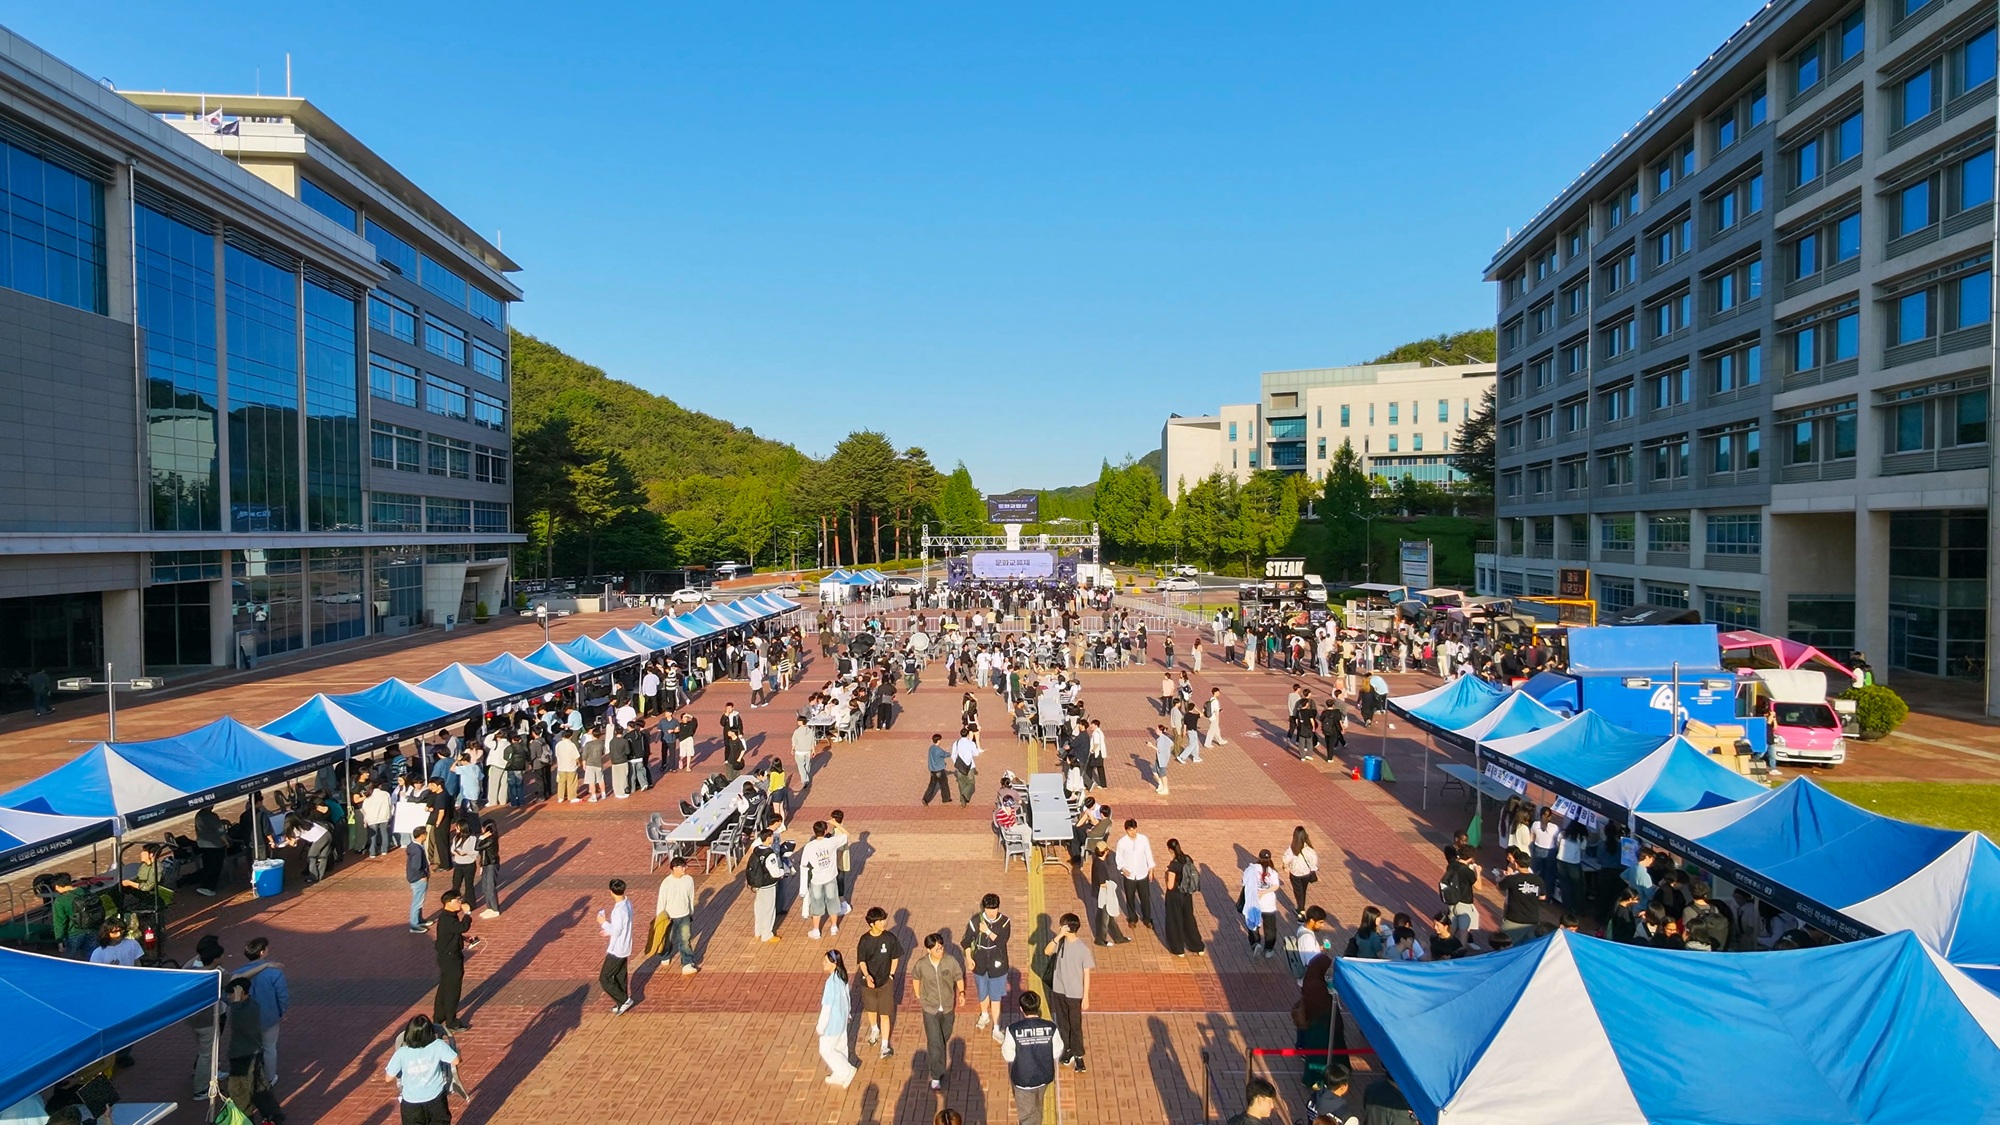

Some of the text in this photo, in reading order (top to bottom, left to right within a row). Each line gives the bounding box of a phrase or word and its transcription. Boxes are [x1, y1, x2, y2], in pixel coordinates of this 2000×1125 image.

[1265, 560, 1305, 577] STEAK
[1795, 902, 1814, 917] 외국인
[1015, 1026, 1052, 1037] UNIST
